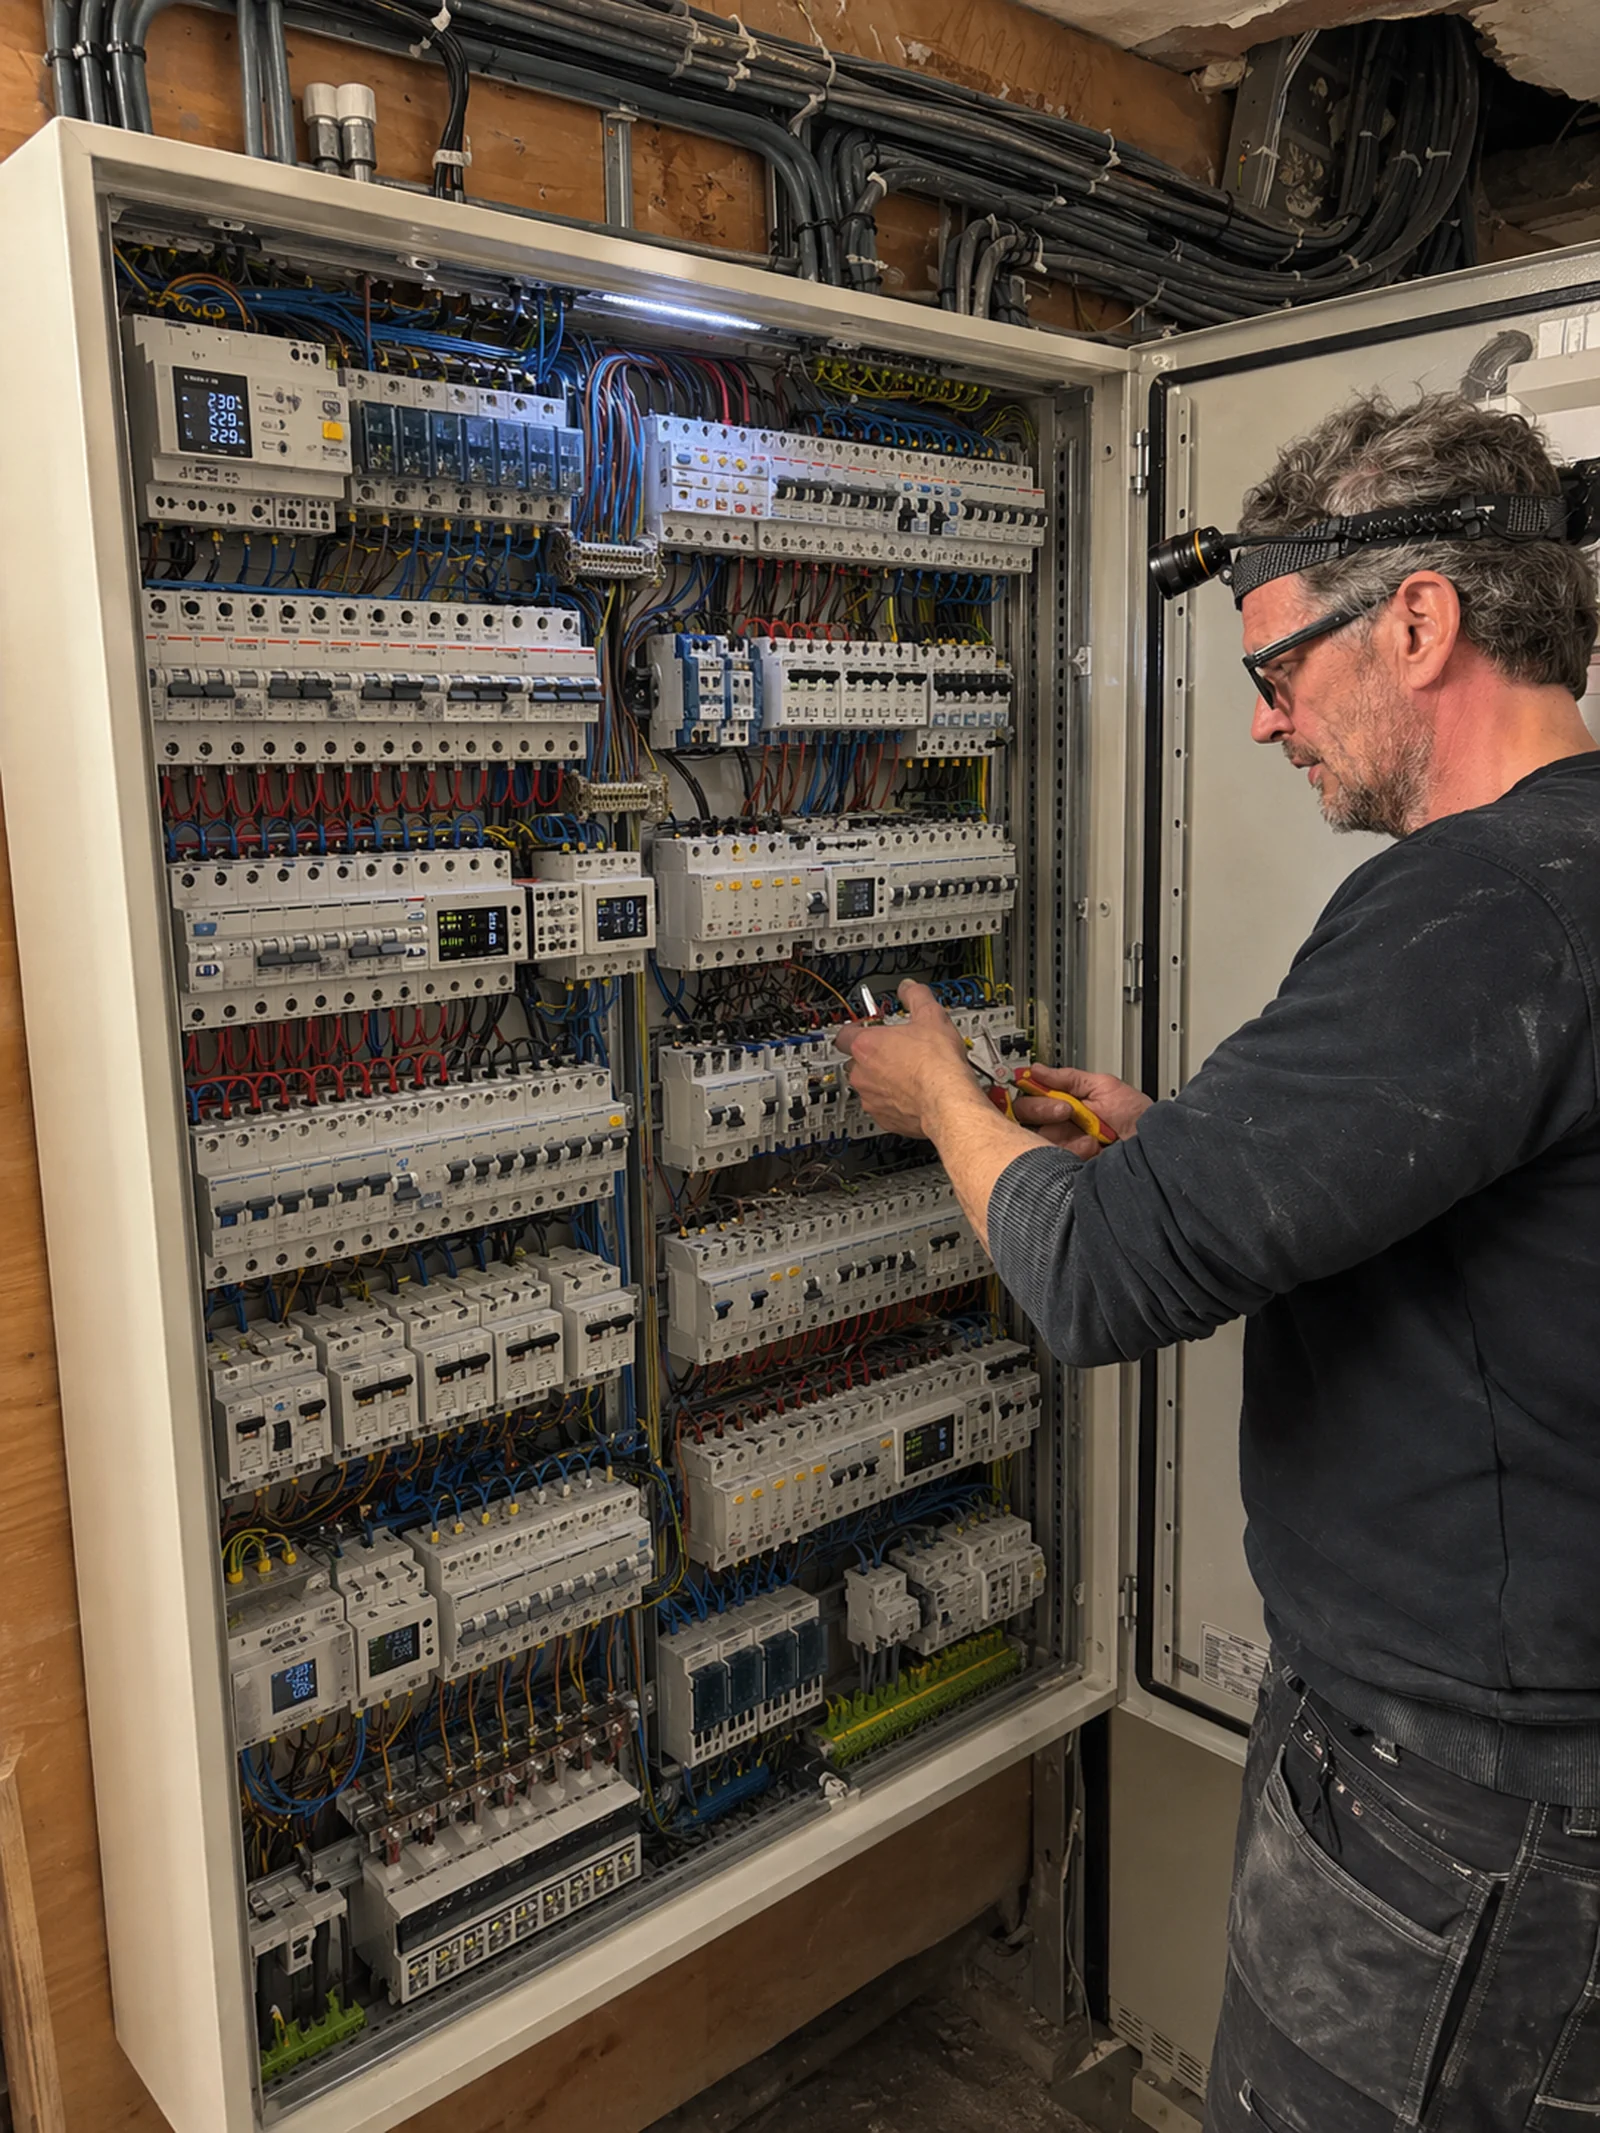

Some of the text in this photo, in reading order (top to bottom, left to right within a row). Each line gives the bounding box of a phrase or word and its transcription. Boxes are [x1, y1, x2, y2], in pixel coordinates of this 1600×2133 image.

[208, 392, 236, 410] 230
[209, 411, 237, 427] 229
[210, 427, 238, 444] 229
